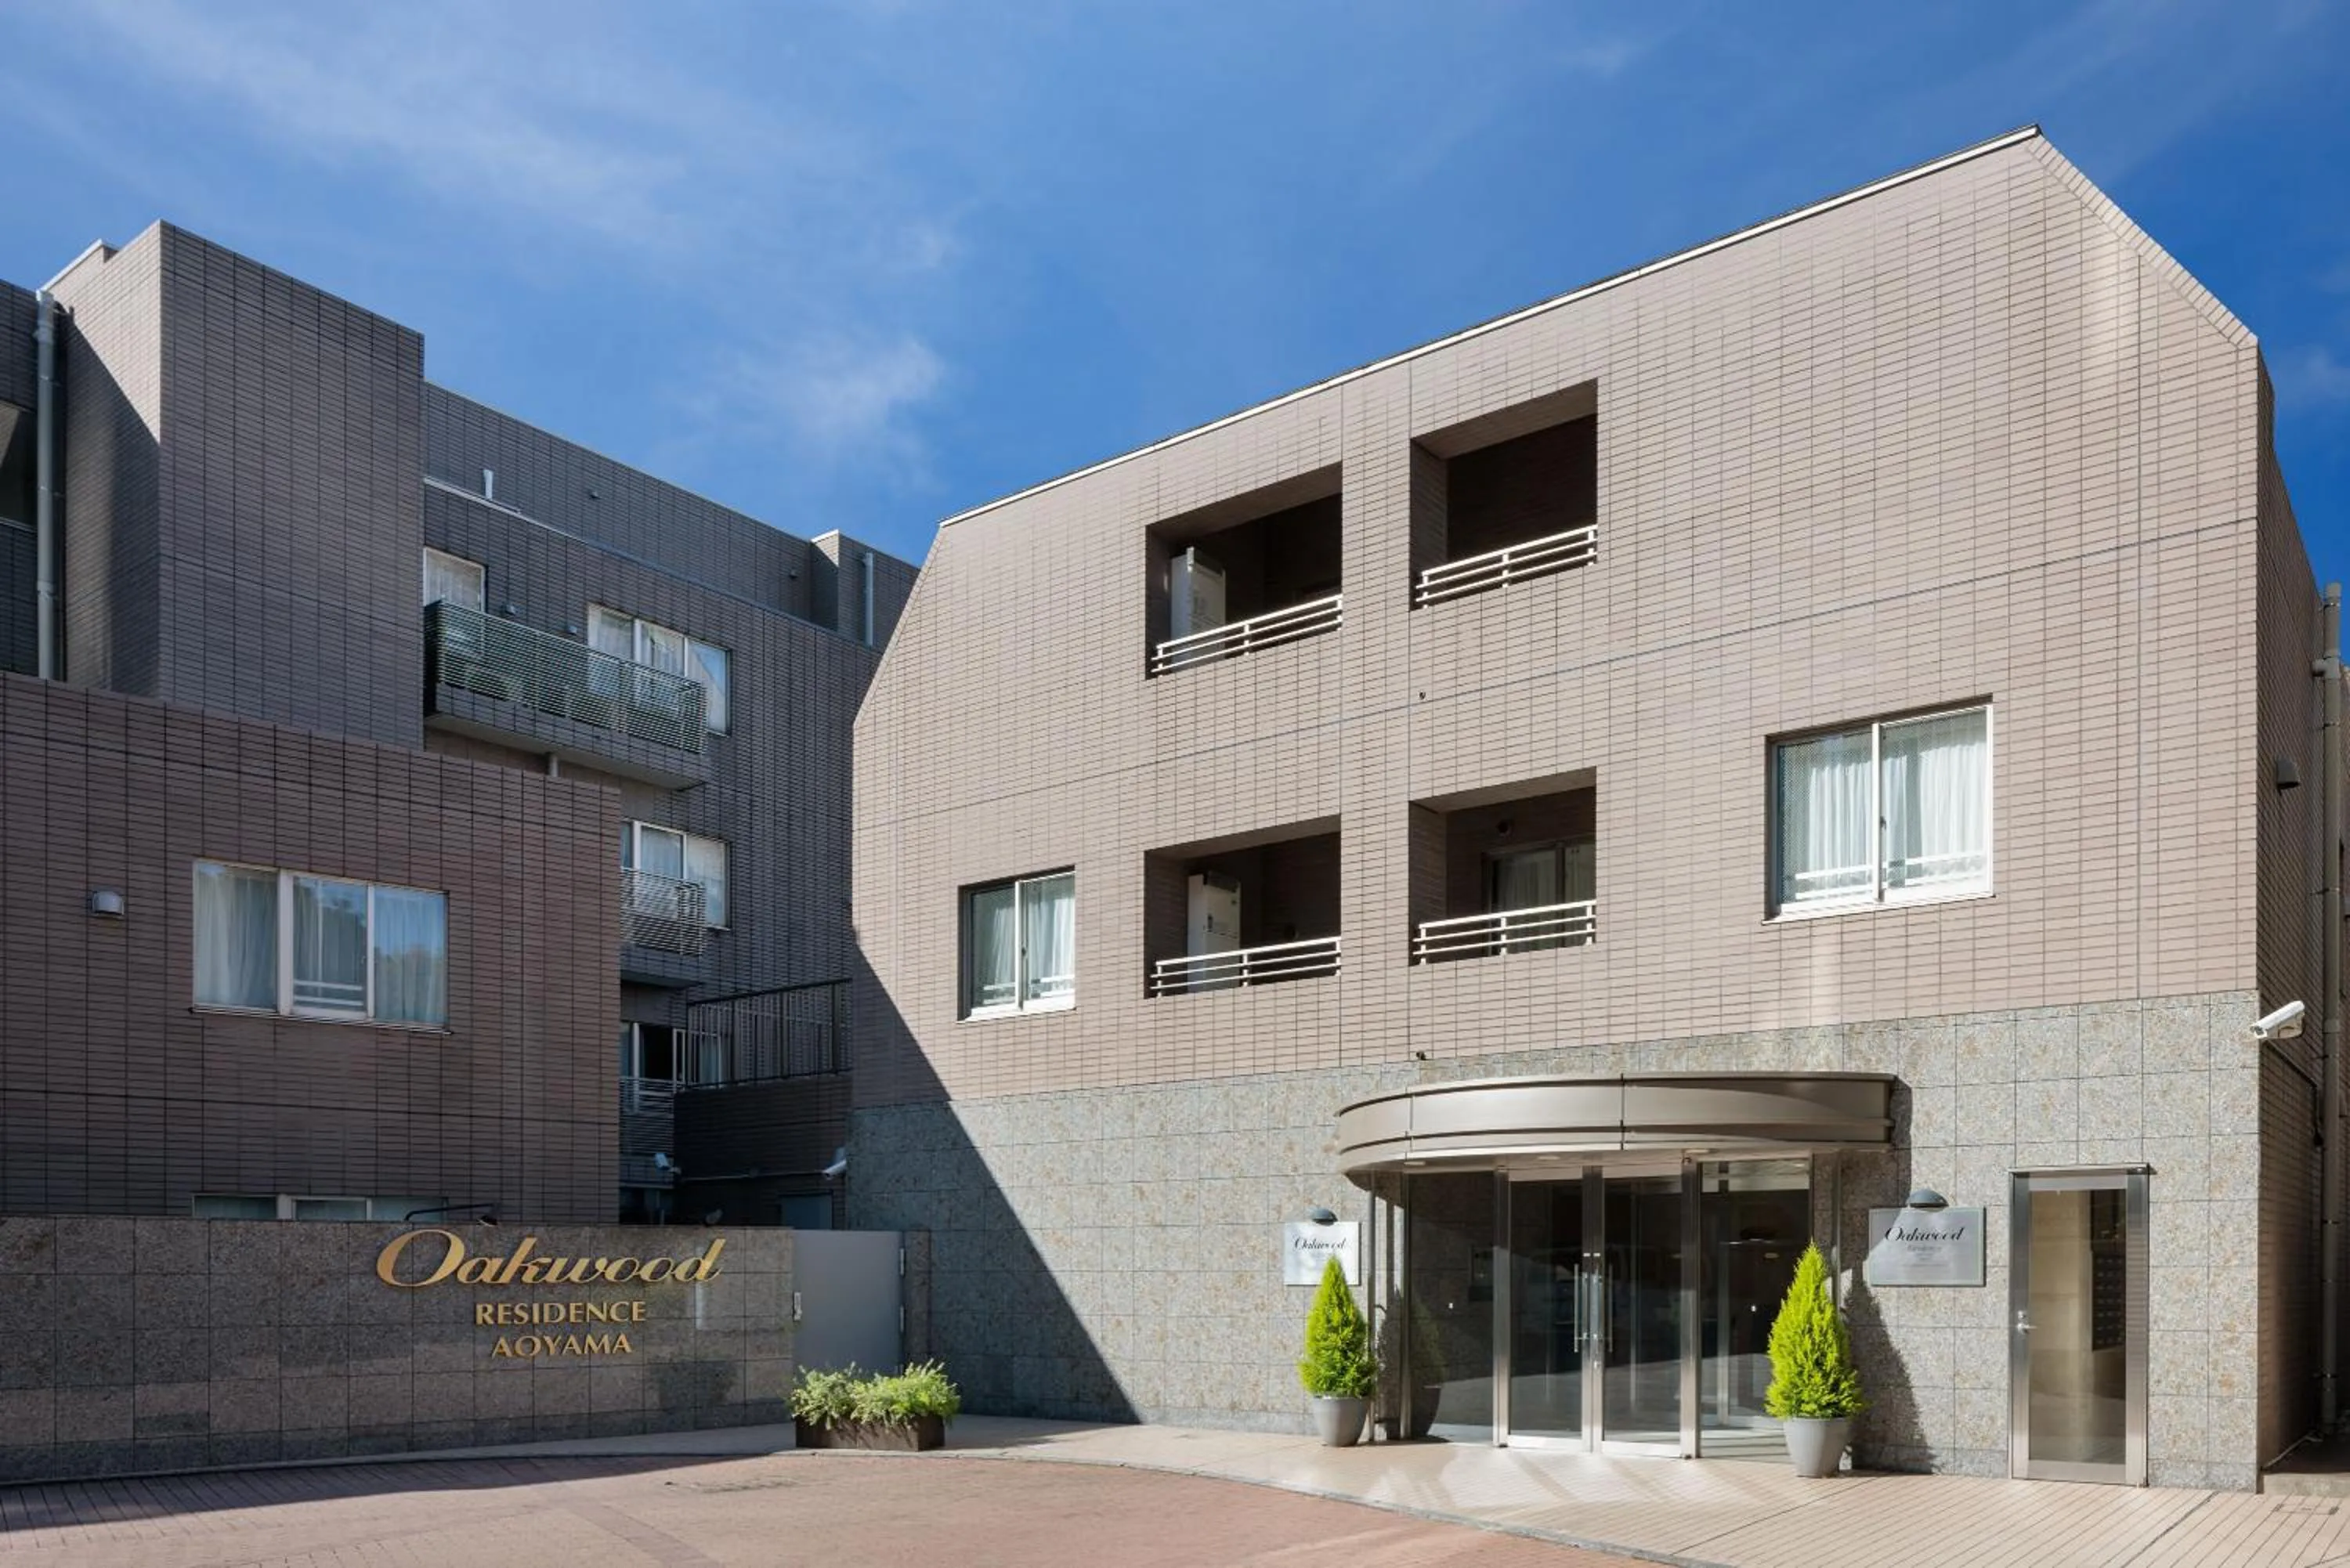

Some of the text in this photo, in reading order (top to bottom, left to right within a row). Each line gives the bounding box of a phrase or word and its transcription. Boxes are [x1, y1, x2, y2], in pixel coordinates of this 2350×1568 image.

[1885, 1227, 1965, 1241] Oakwood
[376, 1229, 726, 1287] Oakwood
[475, 1301, 646, 1326] RESIDENCE
[491, 1333, 633, 1359] AOYAMA
